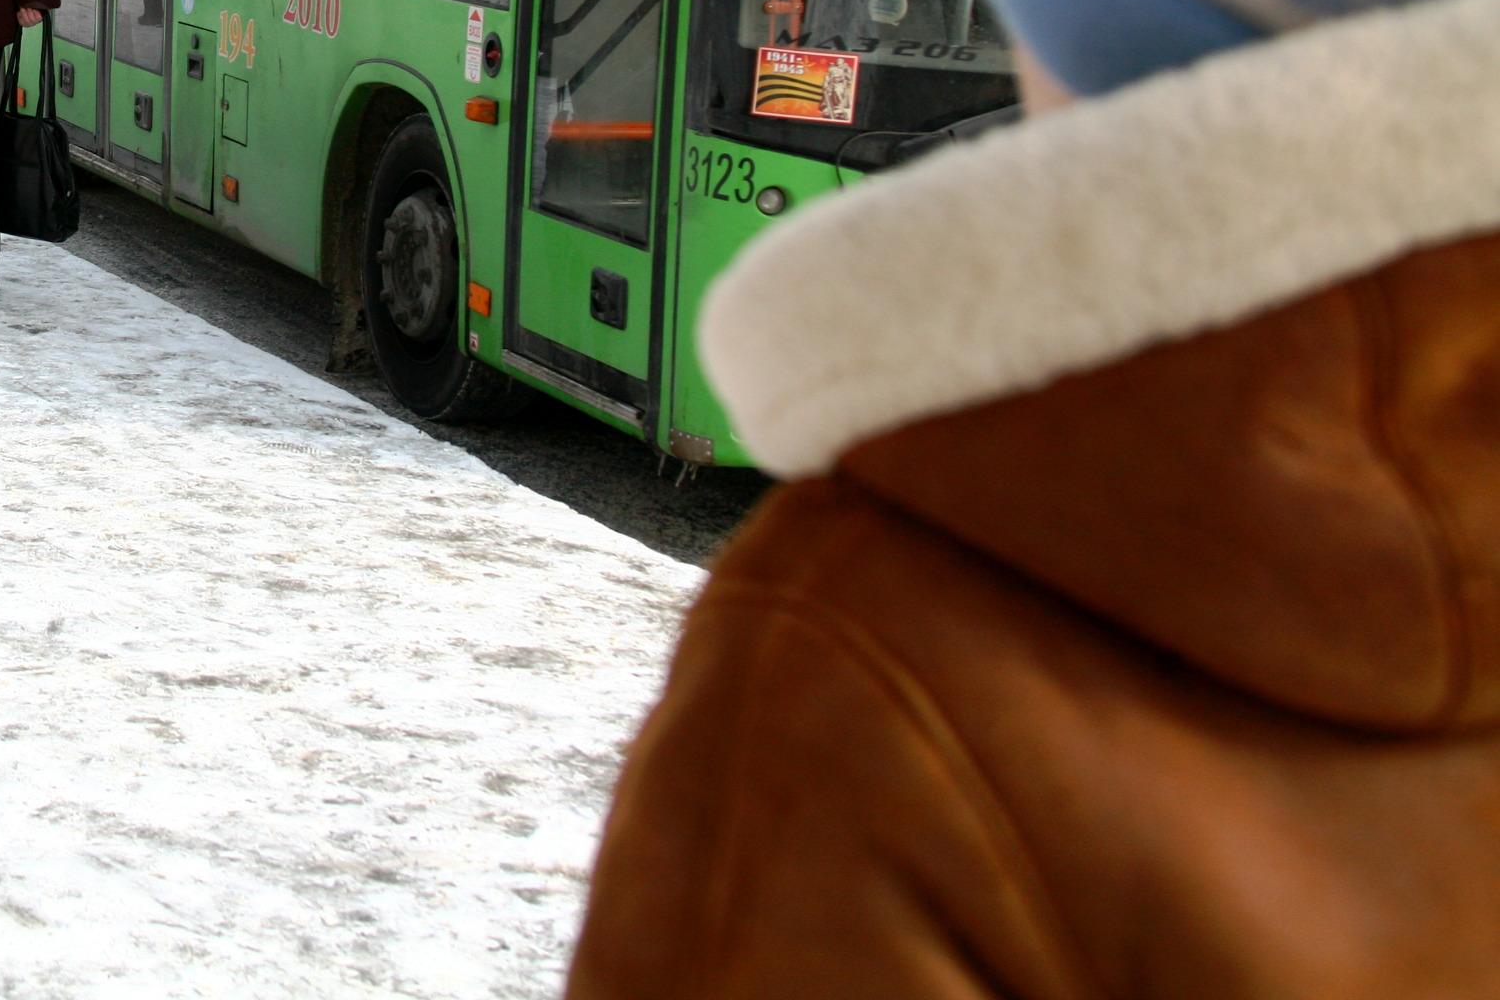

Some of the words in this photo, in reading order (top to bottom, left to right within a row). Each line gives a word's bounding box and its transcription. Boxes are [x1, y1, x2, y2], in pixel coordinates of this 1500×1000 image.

[774, 28, 881, 53] МАЗ
[891, 38, 978, 62] 206
[766, 51, 803, 64] 1941-
[773, 63, 805, 75] 1945
[685, 145, 756, 204] 3123
